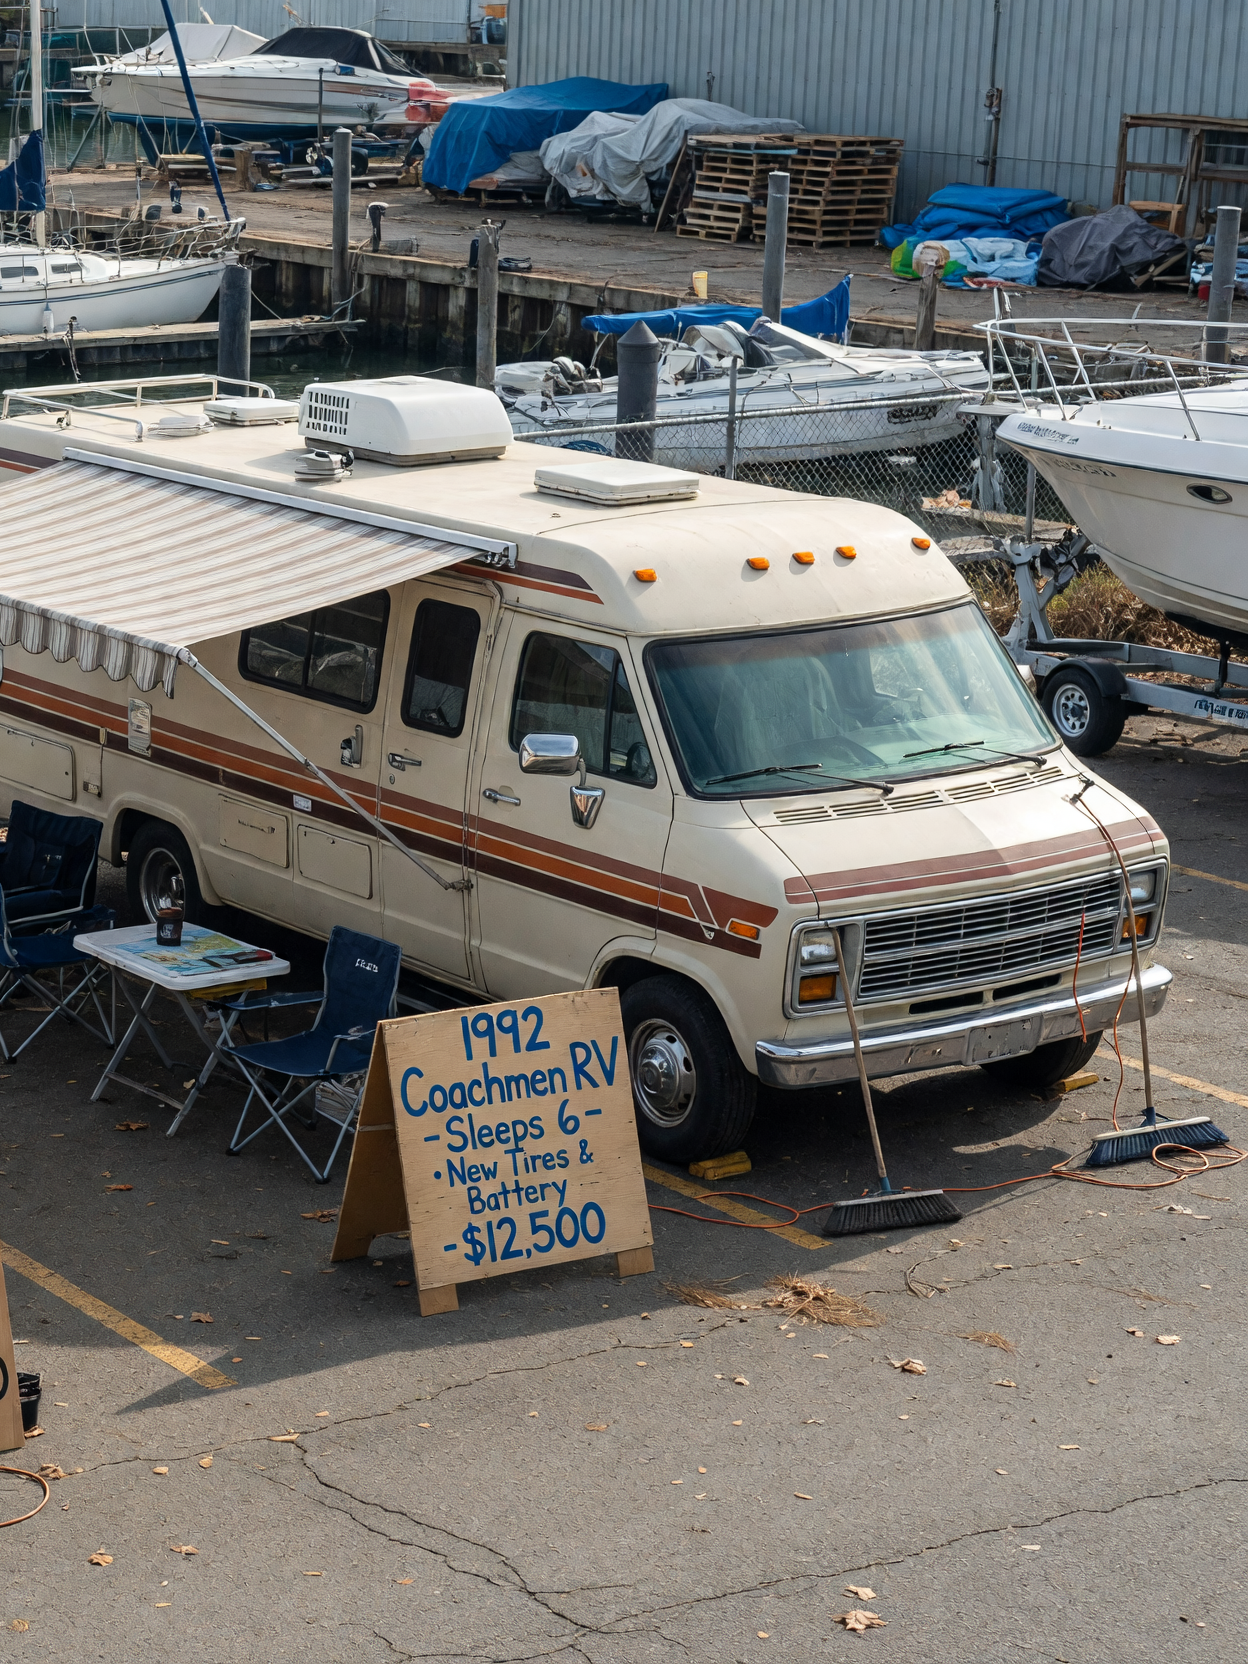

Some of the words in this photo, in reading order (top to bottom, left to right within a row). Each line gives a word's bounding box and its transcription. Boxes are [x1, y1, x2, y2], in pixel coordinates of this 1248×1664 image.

[460, 1005, 551, 1061] 1992
[400, 1061, 568, 1117] Coachmen
[568, 1035, 619, 1091] RV
[504, 1147, 570, 1178] Tires
[579, 1138, 594, 1165] &
[466, 1179, 568, 1215] Battery
